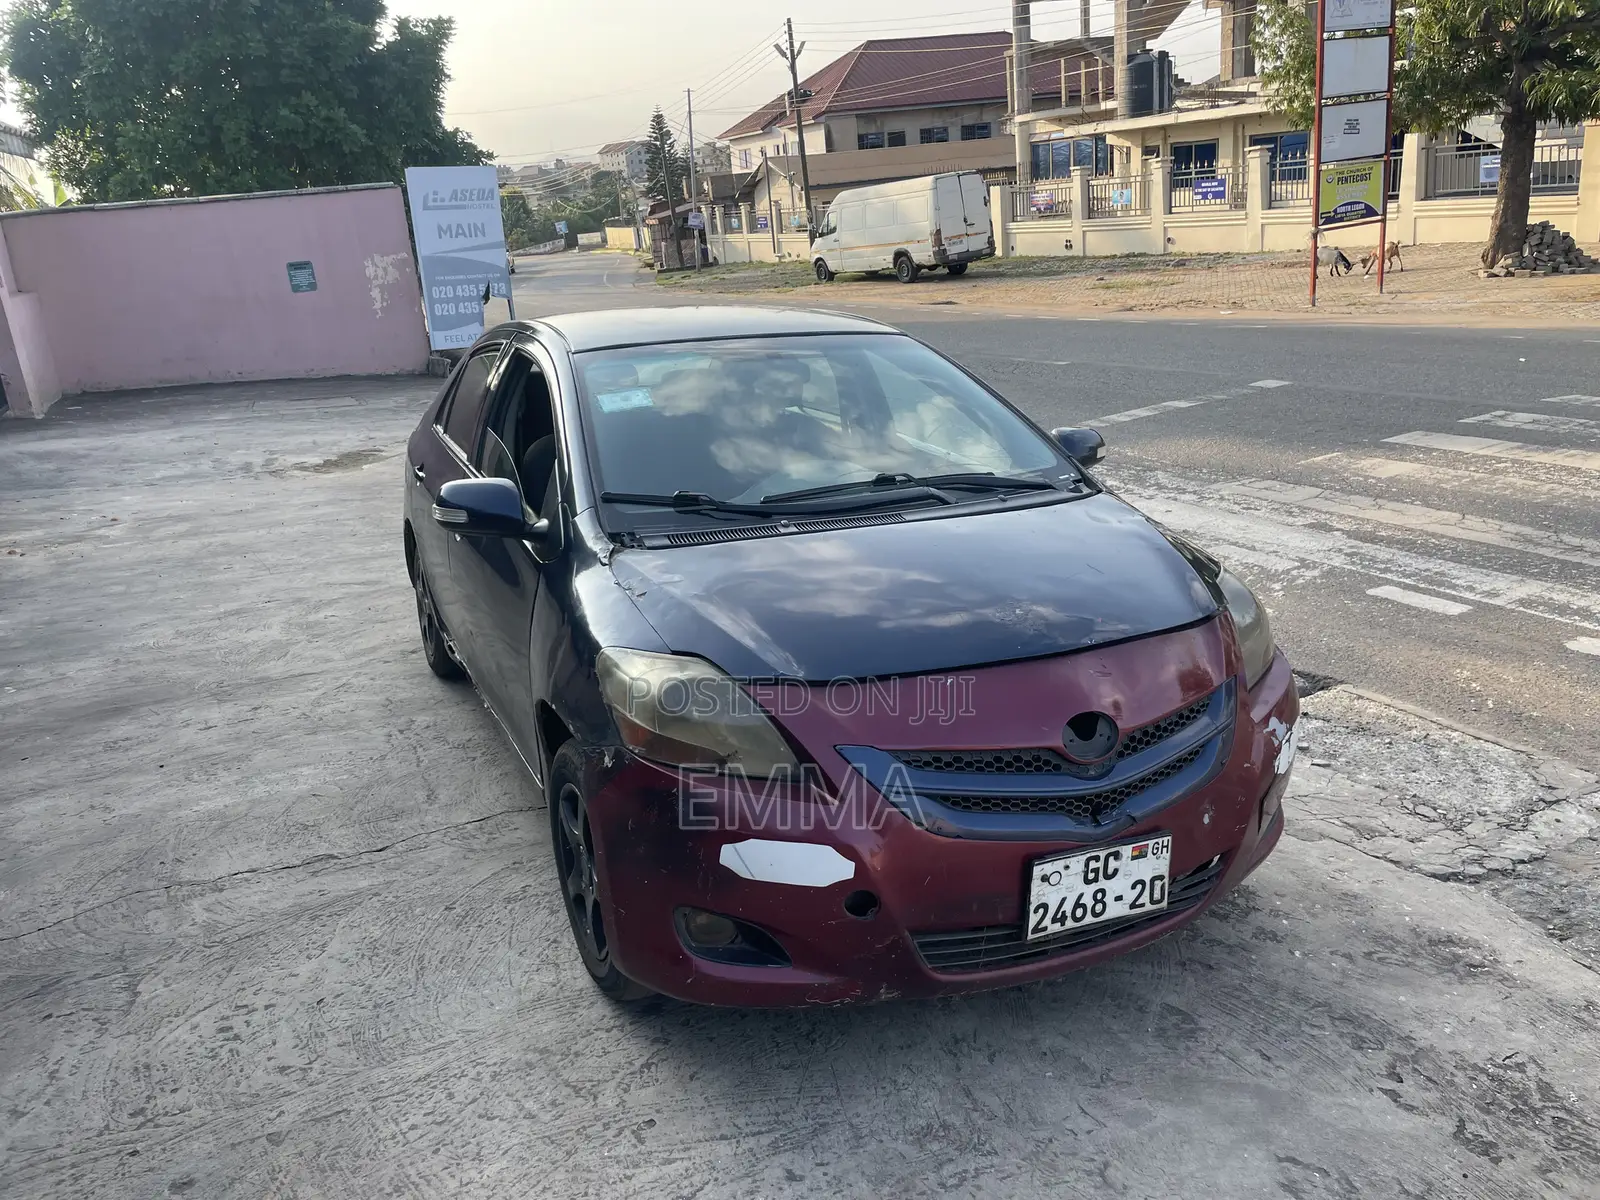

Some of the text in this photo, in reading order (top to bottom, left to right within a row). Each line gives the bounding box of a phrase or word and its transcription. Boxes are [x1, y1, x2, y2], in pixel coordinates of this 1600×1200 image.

[1336, 172, 1371, 185] PENTECOST
[449, 187, 495, 203] ASEDA
[1336, 205, 1352, 213] NORTH
[437, 222, 486, 240] MAIN
[432, 282, 507, 299] 020 435 573
[434, 303, 456, 316] 020
[458, 301, 480, 314] 435
[444, 333, 479, 343] FEEL AT
[1083, 838, 1170, 885] GC GH
